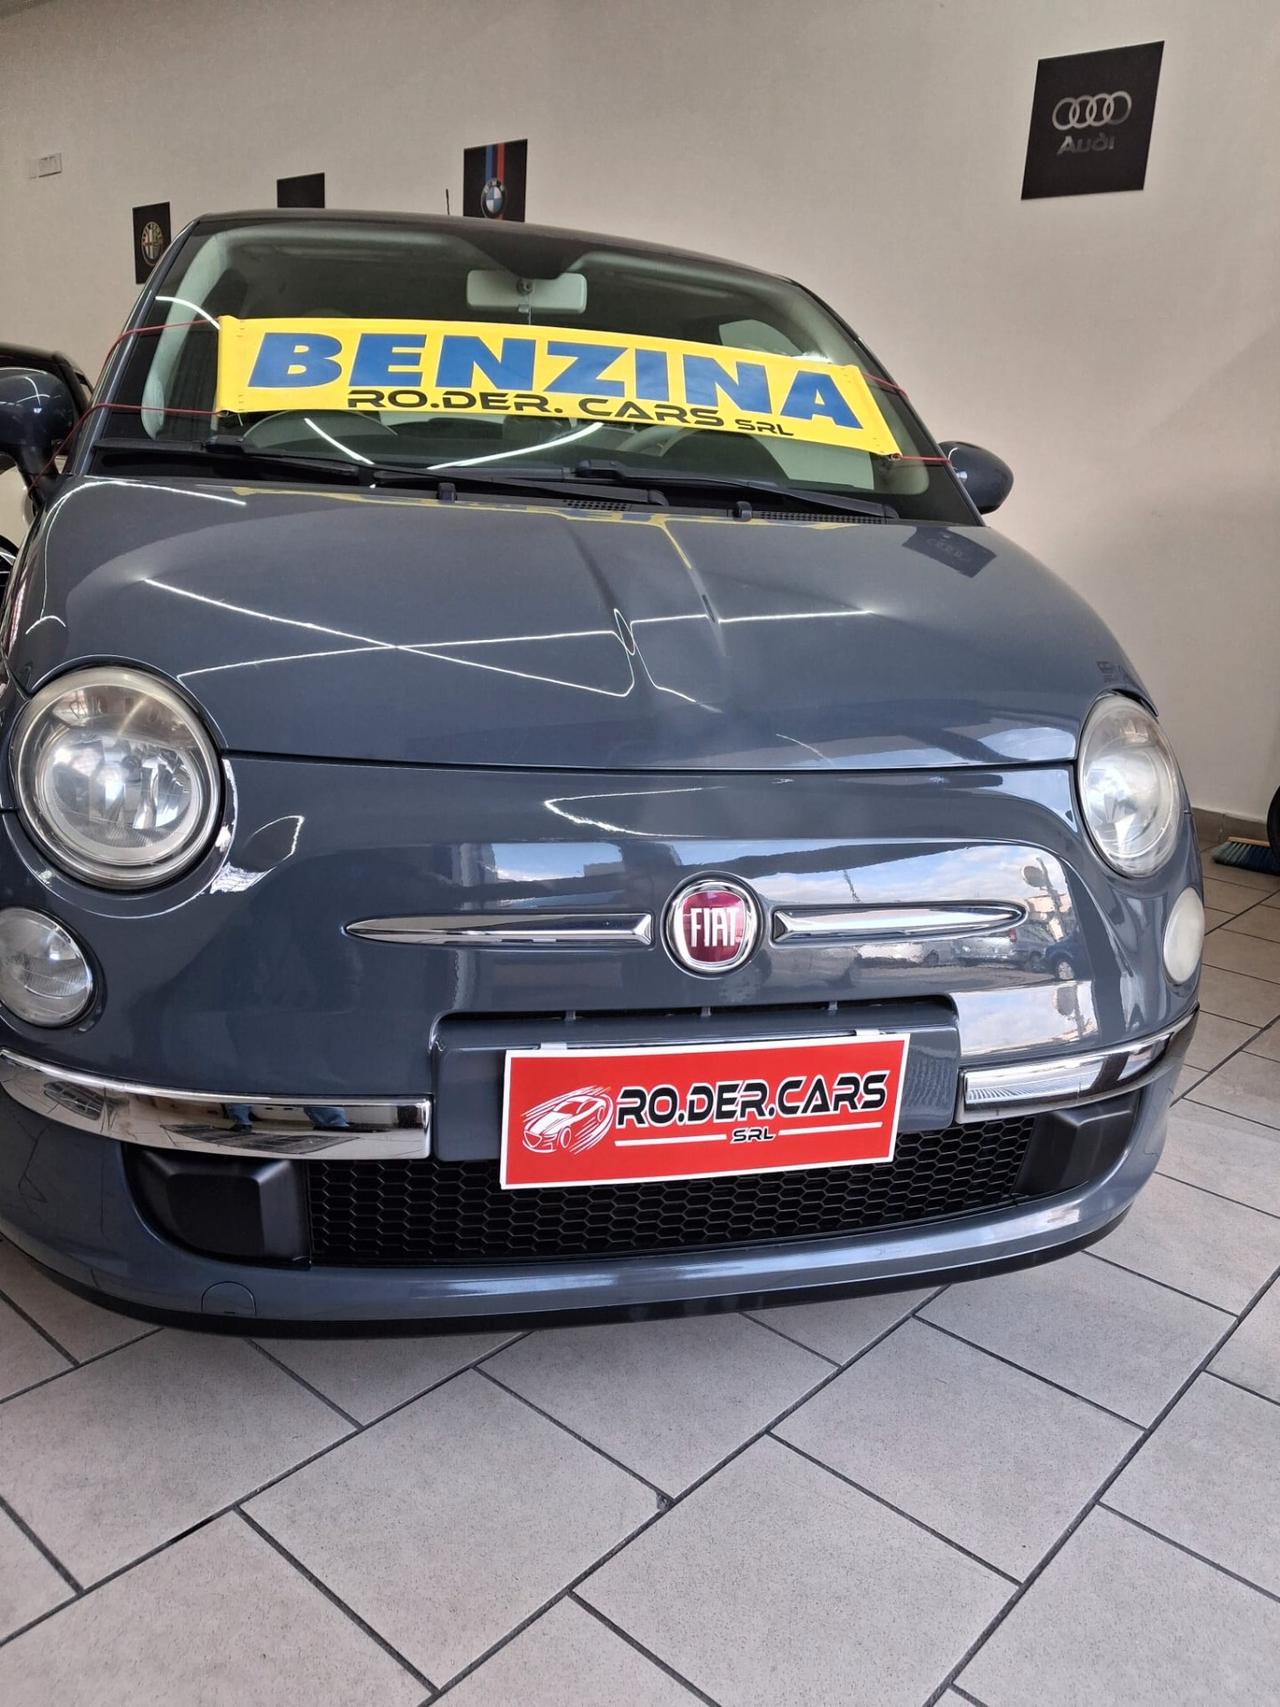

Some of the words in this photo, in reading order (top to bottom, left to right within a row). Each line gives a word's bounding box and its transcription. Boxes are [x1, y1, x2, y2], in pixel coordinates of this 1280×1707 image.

[1058, 132, 1115, 154] Audi
[248, 332, 863, 429] BENZINA
[347, 389, 563, 413] RO.DER.
[579, 397, 724, 427] CARS
[734, 419, 794, 436] SRL
[690, 907, 739, 947] FIAT
[616, 1071, 889, 1128] RO.DER.CARS
[731, 1127, 776, 1143] SRL
